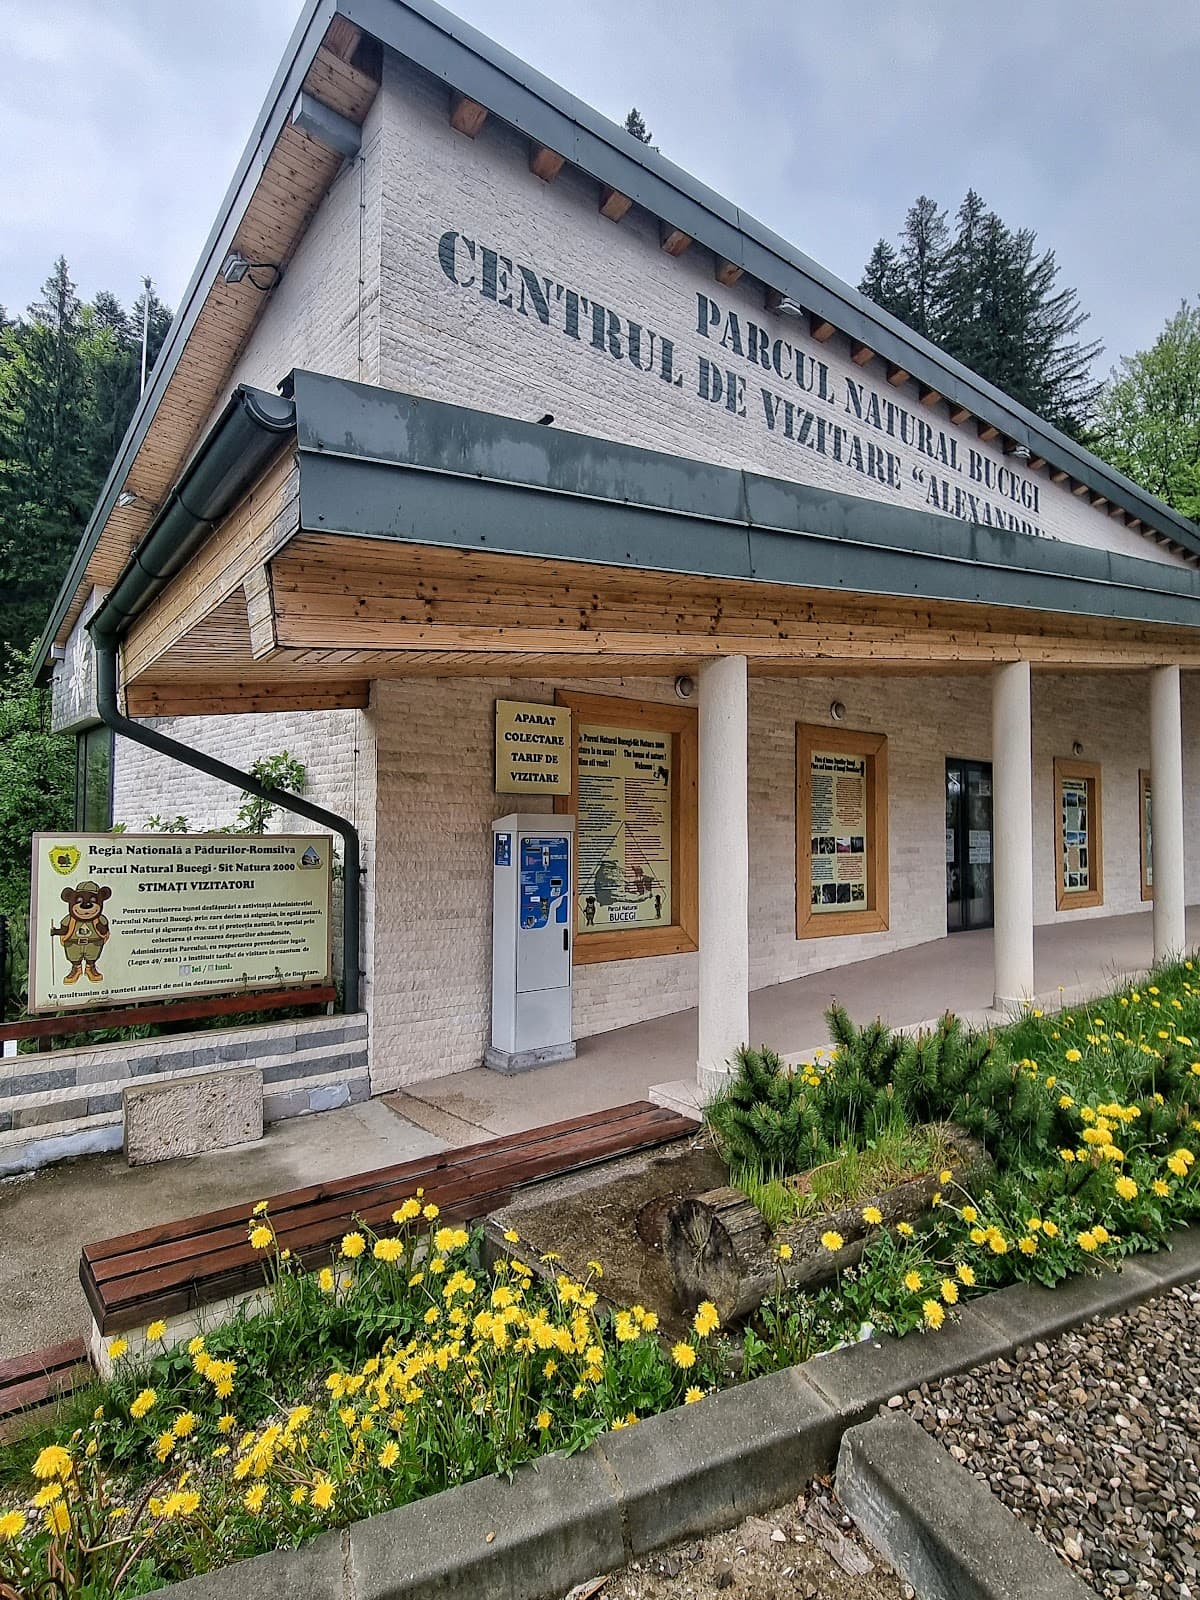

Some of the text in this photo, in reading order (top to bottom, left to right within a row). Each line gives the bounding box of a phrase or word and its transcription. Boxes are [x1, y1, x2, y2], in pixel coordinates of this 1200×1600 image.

[437, 230, 684, 386] CENTRUL
[696, 356, 748, 416] DE
[759, 387, 903, 490] VIZITARE
[695, 291, 1041, 514] PARCUL NATURAL BUCEGI
[514, 713, 557, 726] APARAT
[504, 732, 565, 746] COLECTARE
[511, 752, 559, 764] TARIF DE
[510, 771, 559, 783] VIZITARE
[88, 845, 123, 857] Regia
[88, 865, 127, 874] Parcul
[130, 864, 174, 873] Natural
[176, 863, 212, 874] Bucegi
[218, 863, 234, 872] Sit
[235, 863, 271, 872] Natura
[272, 863, 296, 871] 2000
[138, 880, 255, 893] STIMAȚI VIZITATORI
[142, 916, 169, 924] Natural
[609, 911, 636, 922] BUCEGI
[121, 927, 154, 935] confortul
[131, 947, 178, 955] Administrația
